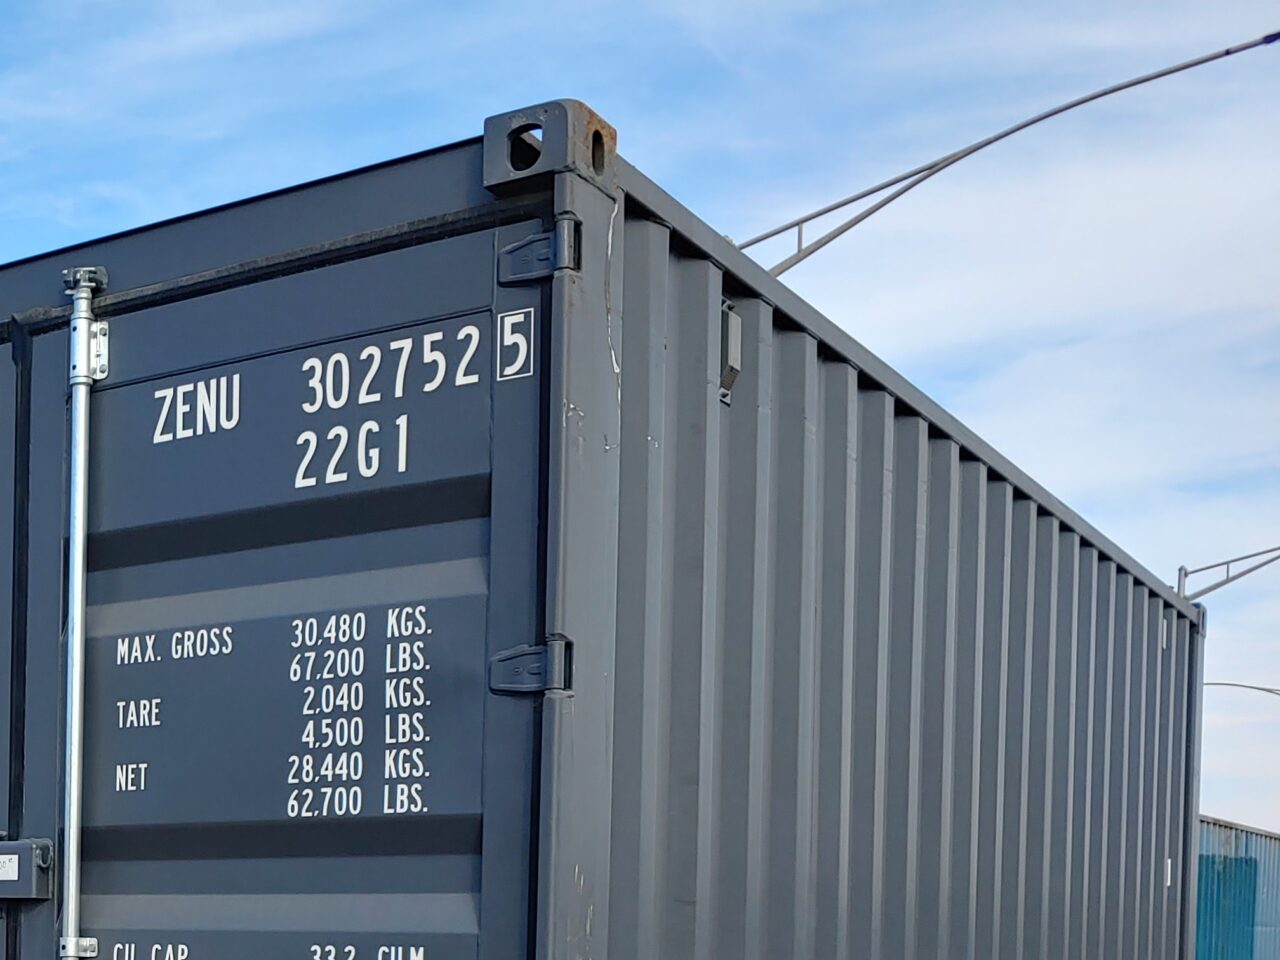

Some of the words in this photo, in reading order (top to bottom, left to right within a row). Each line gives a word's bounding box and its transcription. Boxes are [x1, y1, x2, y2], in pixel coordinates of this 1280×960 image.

[153, 373, 240, 444] ZENU
[294, 414, 408, 489] 22G1
[116, 637, 162, 665] MAX.
[171, 626, 233, 659] GROSS
[290, 612, 366, 648] 30,480
[386, 605, 433, 638] KGS.
[289, 647, 364, 682] 67,200
[385, 641, 431, 673] LBS.
[116, 698, 161, 728] TARE
[302, 682, 364, 715] 2,040
[385, 676, 431, 709] KGS.
[301, 717, 364, 749] 4,500
[385, 712, 430, 744] LBS.
[115, 763, 148, 792] NET
[287, 752, 363, 784] 28,440
[384, 748, 430, 779] KGS.
[287, 786, 362, 818] 62,700
[383, 783, 428, 814] LBS.
